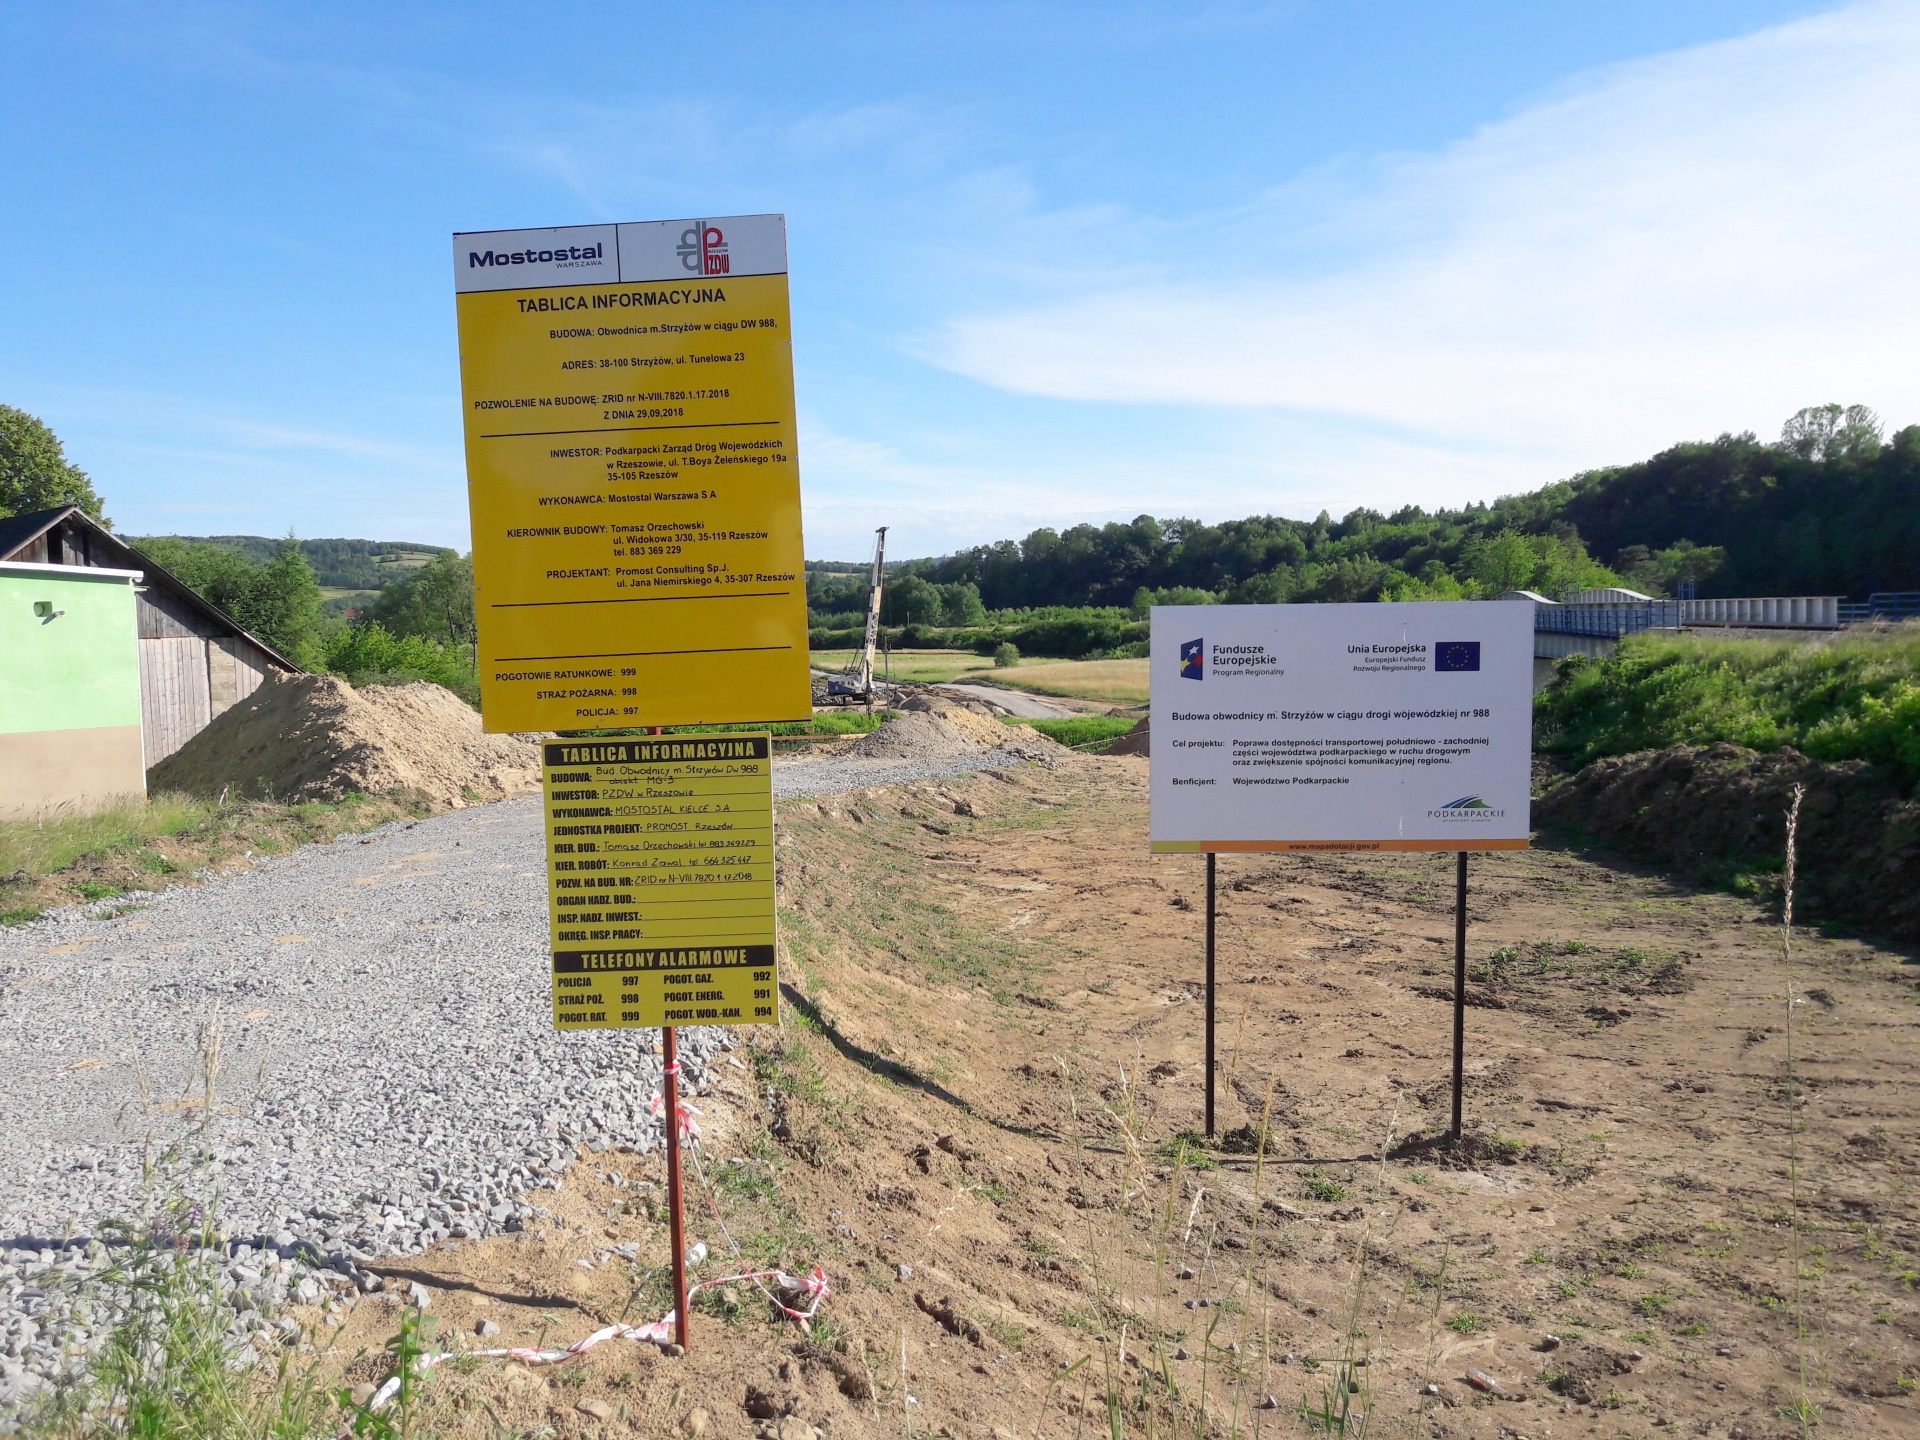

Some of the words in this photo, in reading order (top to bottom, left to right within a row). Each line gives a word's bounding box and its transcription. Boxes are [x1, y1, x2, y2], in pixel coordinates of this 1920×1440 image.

[469, 242, 602, 268] Mostostal
[555, 260, 603, 269] WARSZAWA
[516, 295, 588, 313] TABLICA
[592, 288, 726, 308] INFORMACYJNA
[549, 328, 594, 339] BUDOWA:
[597, 325, 647, 336] Obwodnica
[713, 320, 738, 332] ciągu
[740, 319, 756, 328] DW
[561, 359, 596, 370] ADRES:
[599, 358, 628, 368] 38-100
[688, 353, 732, 363] Tunelowa
[734, 352, 744, 361] 23
[474, 398, 536, 409] POZWOLENIE
[554, 395, 599, 406] BUDOWĘ:
[601, 393, 624, 403] ZRID
[611, 409, 635, 419] DNIA
[550, 447, 602, 458] INWESTOR:
[605, 444, 660, 456] Podkarpacki
[662, 443, 692, 454] Zarząd
[694, 442, 716, 453] Dróg
[718, 439, 782, 452] Wojewódzkich
[771, 453, 786, 462] 19a
[607, 471, 636, 481] 35-105
[638, 469, 678, 479] Rzeszów
[538, 494, 605, 506] WYKONAWCA:
[608, 492, 651, 502] Mostostal
[653, 492, 699, 500] Warszawa
[506, 526, 561, 537] KIEROWNIK
[563, 524, 607, 535] BUDOWY:
[610, 524, 644, 533] Tomasz
[646, 520, 704, 531] Orzechowski
[625, 535, 672, 544] Widokowa
[697, 531, 726, 541] 35-119
[728, 530, 768, 539] Rzeszów
[629, 546, 645, 555] 883
[647, 545, 663, 555] 369
[665, 545, 681, 554] 229
[546, 567, 610, 579] PROJEKTANT:
[615, 566, 654, 575] Promost
[655, 564, 704, 574] Consulting
[629, 578, 651, 587] Jana
[653, 576, 712, 586] Niemirskiego
[724, 573, 753, 583] 35-307
[756, 572, 795, 582] Rzeszów
[1213, 644, 1264, 654] Fundusze
[1347, 644, 1369, 653] Unia
[1372, 643, 1426, 654] Europejska
[1213, 654, 1276, 666] Europejskie
[1364, 656, 1398, 664] Europejski
[495, 671, 551, 681] POGOTOWIE
[553, 668, 616, 678] RATUNKOWE:
[620, 667, 636, 676] 999
[1212, 669, 1243, 677] Program
[1244, 668, 1284, 677] Regionalny
[1381, 664, 1426, 672] Regionalnego
[536, 688, 567, 699] STRAŻ
[568, 688, 617, 698] POŻARNA:
[621, 687, 637, 695] 998
[576, 707, 618, 717] POLICJA:
[623, 706, 638, 715] 997
[1172, 712, 1210, 720] Budowa
[1212, 711, 1264, 721] obwodnicy
[1280, 710, 1324, 721] Strzyżów
[1337, 710, 1363, 721] ciągu
[1365, 709, 1391, 720] drogi
[1393, 708, 1457, 720] wojewódzkiej
[1472, 708, 1489, 717] 988
[1172, 739, 1186, 747] Cel
[1188, 739, 1225, 748] projektu:
[1232, 739, 1269, 748] Poprawa
[1271, 738, 1323, 748] dostępności
[1325, 738, 1384, 747] transportowej
[1386, 737, 1436, 746] południowo
[1443, 736, 1489, 746] zachodniej
[560, 746, 627, 762] TABLICA
[634, 742, 755, 760] INFORMACYJNA
[1232, 748, 1259, 757] części
[1260, 748, 1317, 757] województwa
[1319, 747, 1387, 757] podkarpackiego
[1425, 747, 1470, 757] drogowym
[1252, 758, 1303, 767] zwiększenie
[1305, 757, 1346, 766] spójności
[1348, 756, 1415, 766] komunikacyjnej
[1417, 756, 1452, 766] regionu.
[620, 766, 670, 776] Obwodnicy
[550, 772, 592, 783] BUDOWA:
[1172, 777, 1216, 786] Benficjent:
[1232, 777, 1290, 786] Województwo
[1292, 776, 1349, 785] Podkarpackie
[551, 789, 600, 801] INWESTOR:
[602, 789, 634, 798] PZDW
[646, 788, 694, 796] Rzeszowie
[552, 806, 613, 818] WYKONAWCA:
[616, 805, 674, 815] MOSTOSTAL
[1427, 809, 1506, 818] PODKARPACKIE
[553, 824, 602, 836] JEDNOSTKA
[603, 823, 643, 834] PROJEKT:
[646, 822, 688, 831] PROMOST
[696, 822, 734, 830] Rzeszów
[554, 842, 576, 853] KIER.
[604, 841, 640, 850] Tomasz
[643, 840, 696, 850] Orzechowski
[554, 860, 577, 871] KIER.
[578, 858, 610, 870] ROBÓT:
[555, 878, 582, 888] POZW.
[597, 877, 618, 887] BUD.
[634, 876, 656, 884] ZRID
[556, 895, 586, 906] ORGAN
[588, 894, 612, 905] NADZ.
[557, 913, 578, 923] INSP.
[579, 912, 604, 923] NADZ.
[590, 929, 611, 940] INSP.
[612, 928, 643, 939] PRACY:
[580, 952, 654, 968] TELEFONY
[658, 948, 746, 966] ALARMOWE
[557, 976, 592, 987] POLICJA
[622, 975, 638, 986] 997
[663, 973, 693, 984] POGOT.
[694, 973, 714, 983] GAZ.
[753, 971, 771, 981] 992
[557, 993, 585, 1005] STRAŻ
[620, 993, 639, 1004] 998
[663, 991, 694, 1002] POGOT.
[695, 990, 724, 1001] ENERG.
[753, 988, 770, 999] 991
[558, 1012, 588, 1023] POGOT.
[589, 1011, 607, 1022] RAT.
[621, 1011, 639, 1021] 999
[664, 1009, 694, 1019] POGOT.
[754, 1006, 772, 1016] 994
